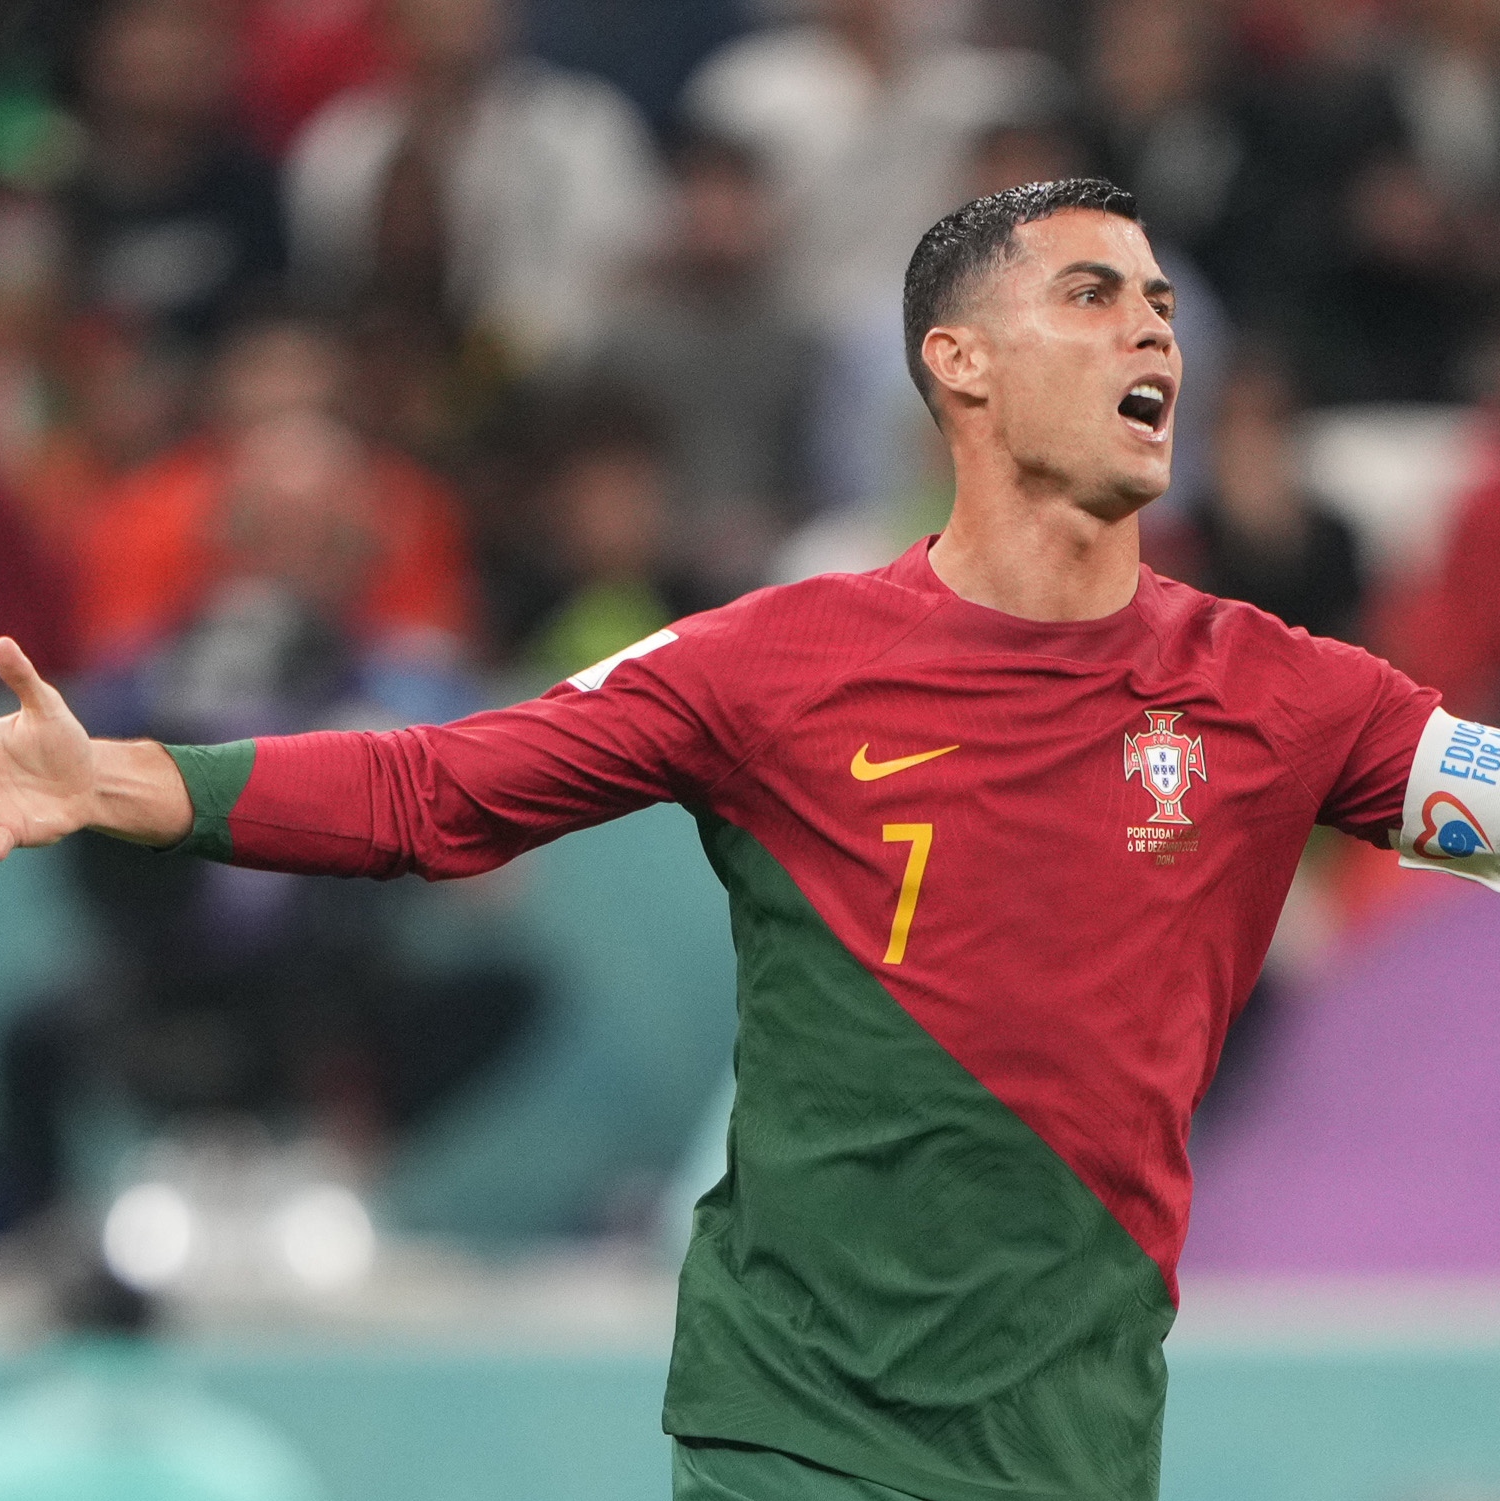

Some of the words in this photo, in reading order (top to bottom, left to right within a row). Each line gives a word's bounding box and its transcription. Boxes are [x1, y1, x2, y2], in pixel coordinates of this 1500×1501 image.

[1127, 827, 1175, 840] PORTUGAL
[1127, 840, 1134, 852] 6
[1135, 840, 1146, 852] DE
[882, 823, 933, 965] 7
